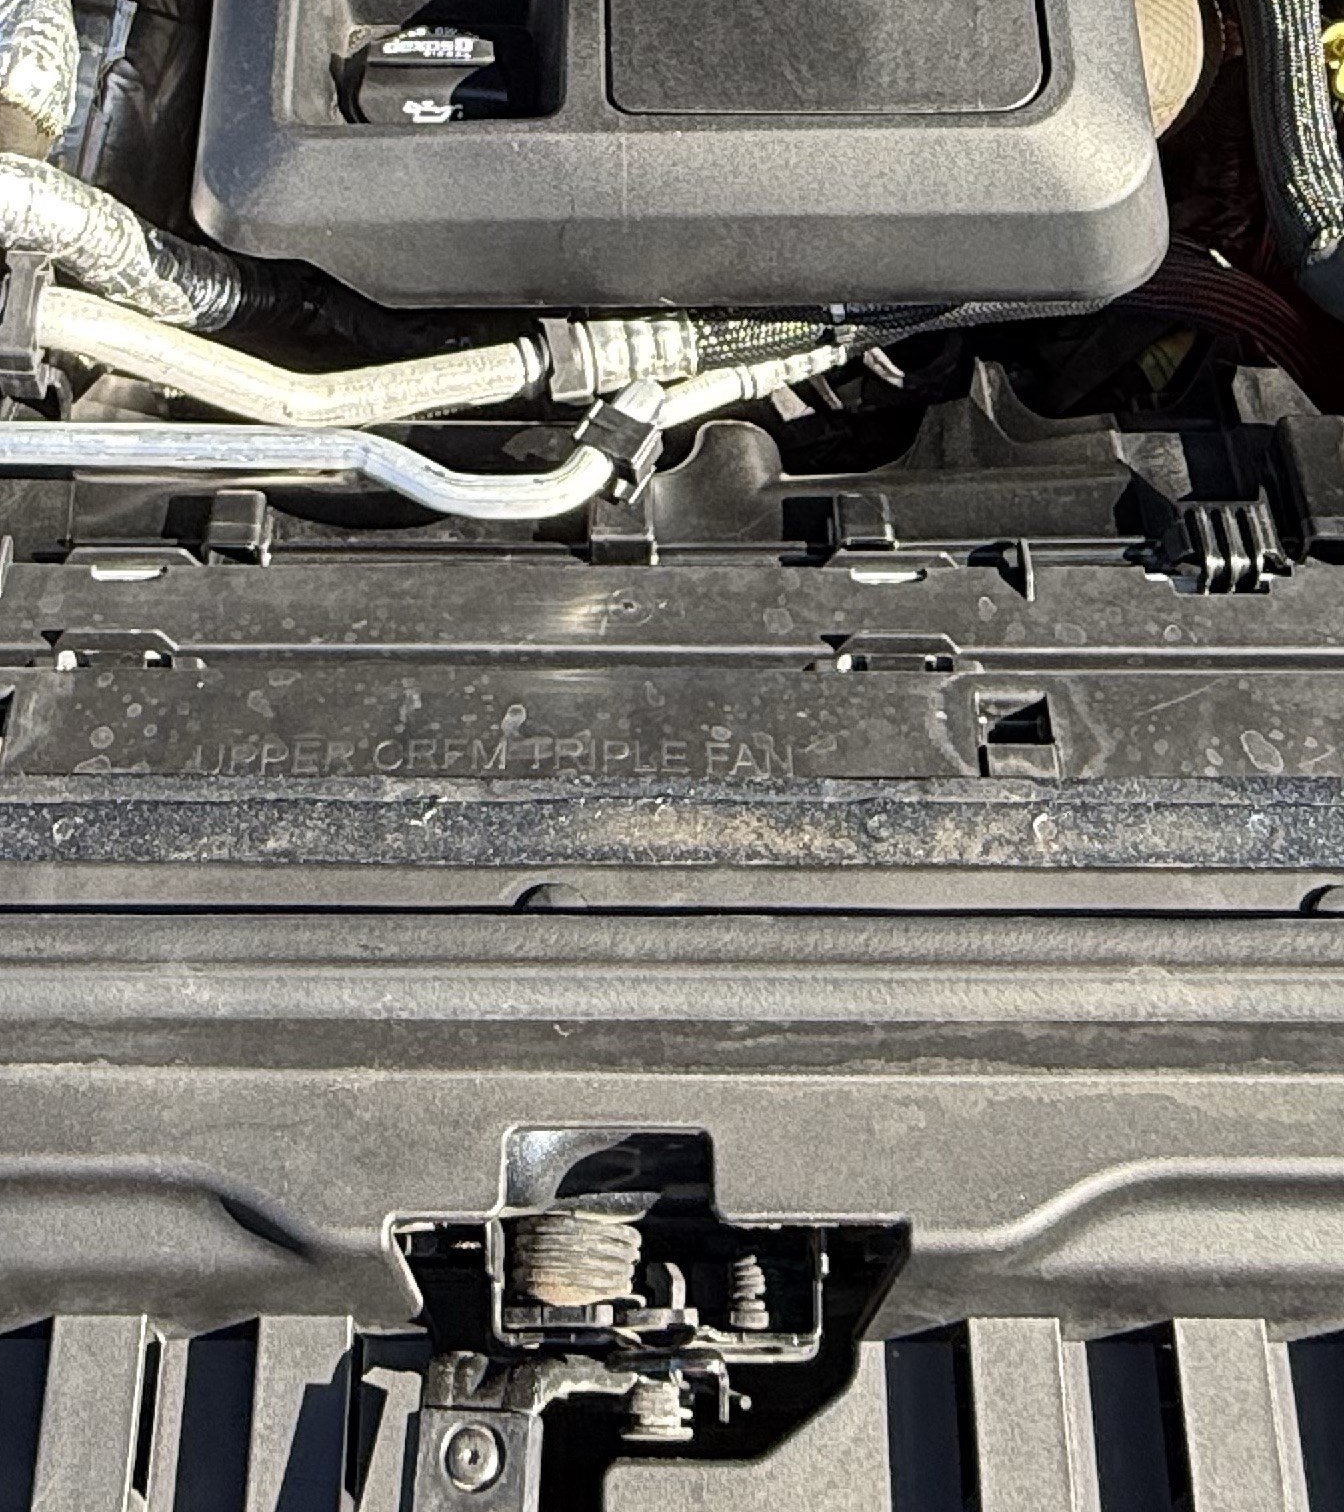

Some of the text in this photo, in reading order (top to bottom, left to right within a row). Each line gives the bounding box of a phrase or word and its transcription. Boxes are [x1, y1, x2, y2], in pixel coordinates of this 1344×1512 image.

[194, 738, 355, 775] UPPER
[516, 737, 691, 774] TRIPLE
[706, 741, 794, 778] FAN
